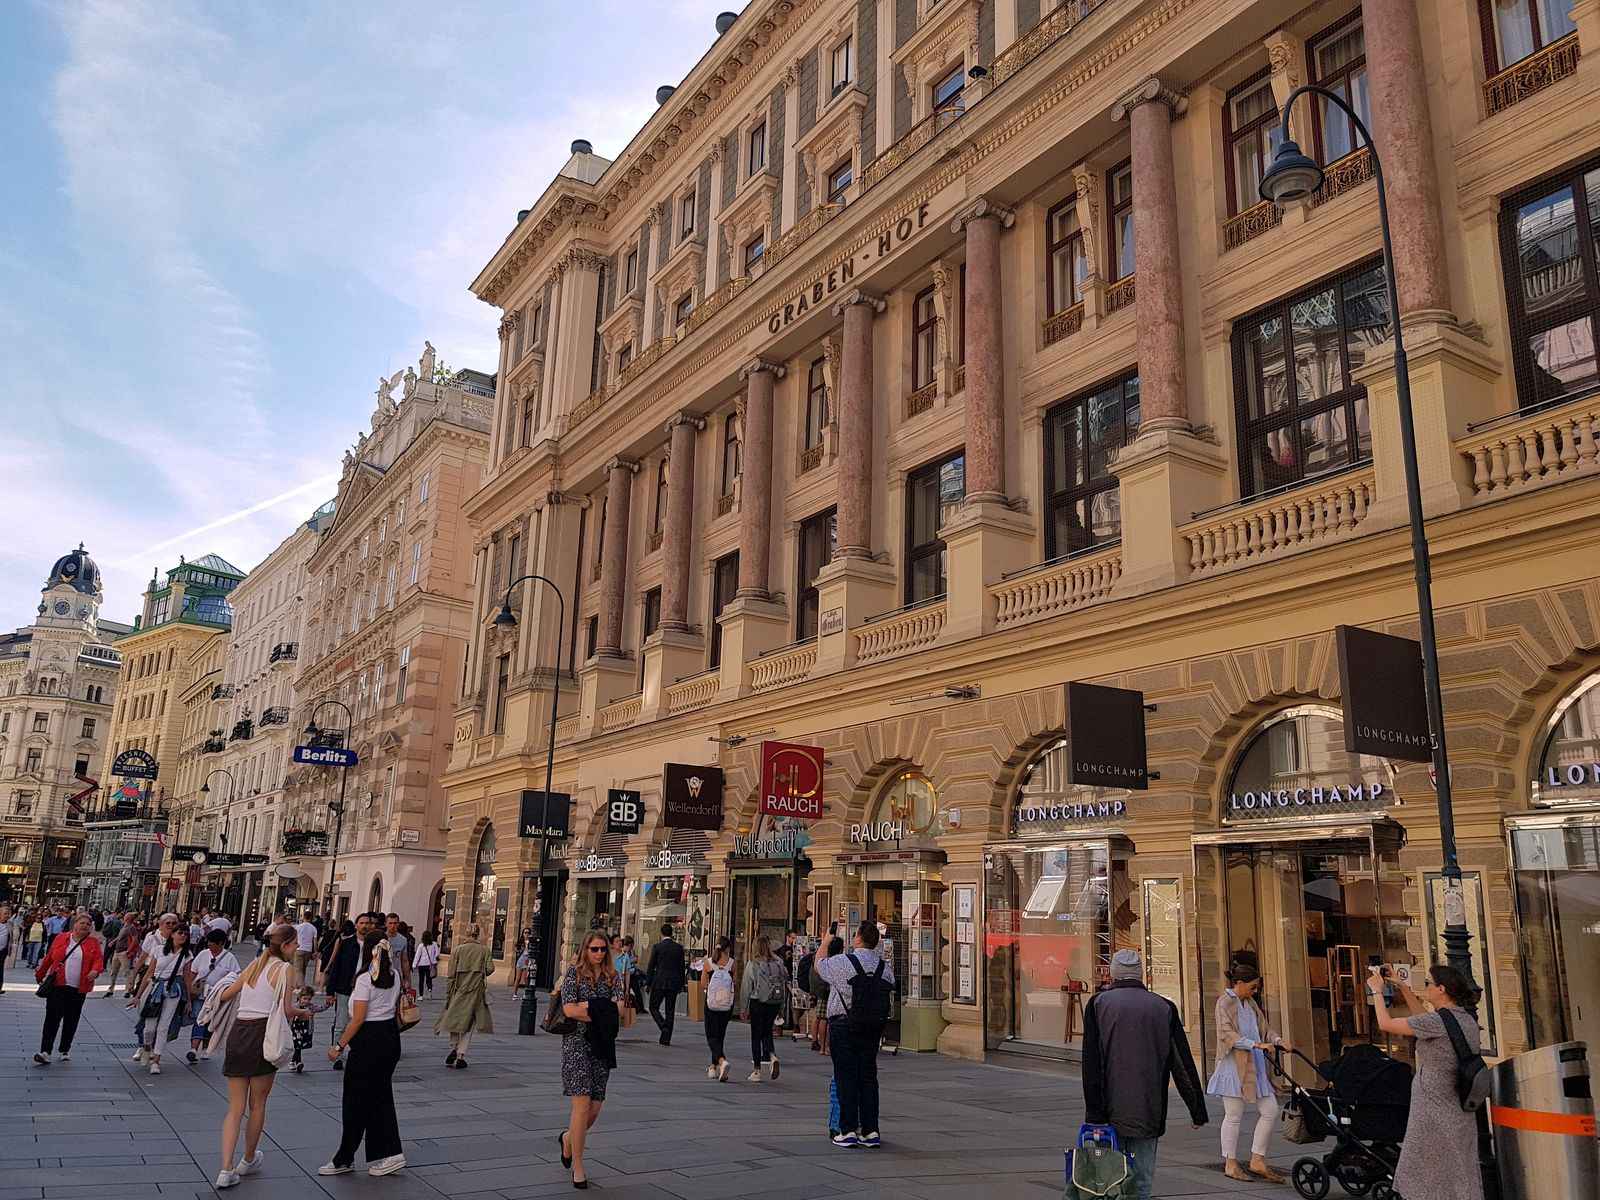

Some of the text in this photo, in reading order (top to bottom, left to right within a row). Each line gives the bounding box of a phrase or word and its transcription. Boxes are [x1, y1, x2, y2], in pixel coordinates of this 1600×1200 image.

[768, 258, 854, 334] GRABEN
[877, 202, 930, 257] HOF
[1356, 725, 1427, 746] LONGCHAMP
[301, 748, 347, 763] Berlitz
[122, 765, 147, 773] BUFFET
[1076, 762, 1144, 777] LONGCHAMP
[767, 795, 819, 814] RAUCH
[1231, 783, 1384, 810] LONGCHAMP
[668, 801, 719, 816] Wellendorff
[1019, 801, 1123, 822] LONGCHAMP
[733, 828, 797, 856] Wellendorff
[850, 820, 904, 843] RAUCH
